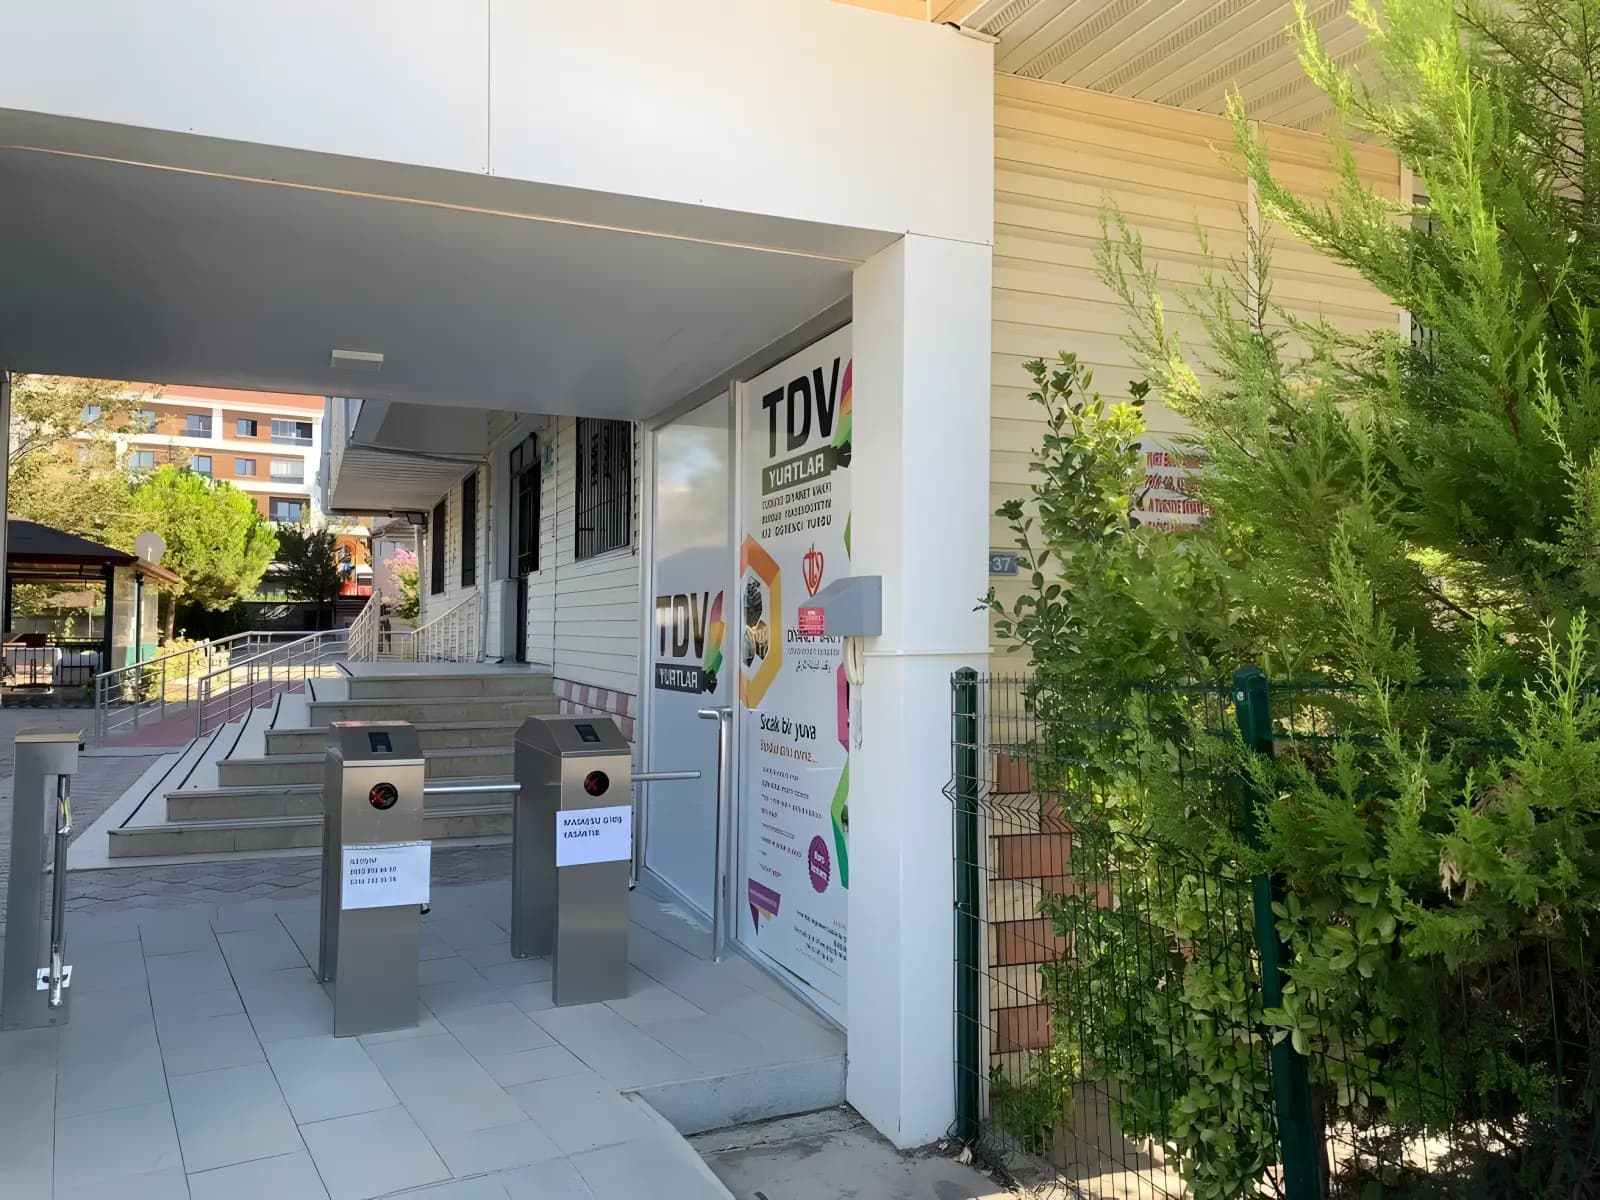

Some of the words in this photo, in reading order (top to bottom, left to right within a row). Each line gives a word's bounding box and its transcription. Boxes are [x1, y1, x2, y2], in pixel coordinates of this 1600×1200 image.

[762, 356, 840, 459] TDV
[768, 452, 825, 489] YURTLAR
[992, 557, 1011, 572] 37
[656, 591, 709, 659] TDV
[659, 667, 698, 689] YURTLAR
